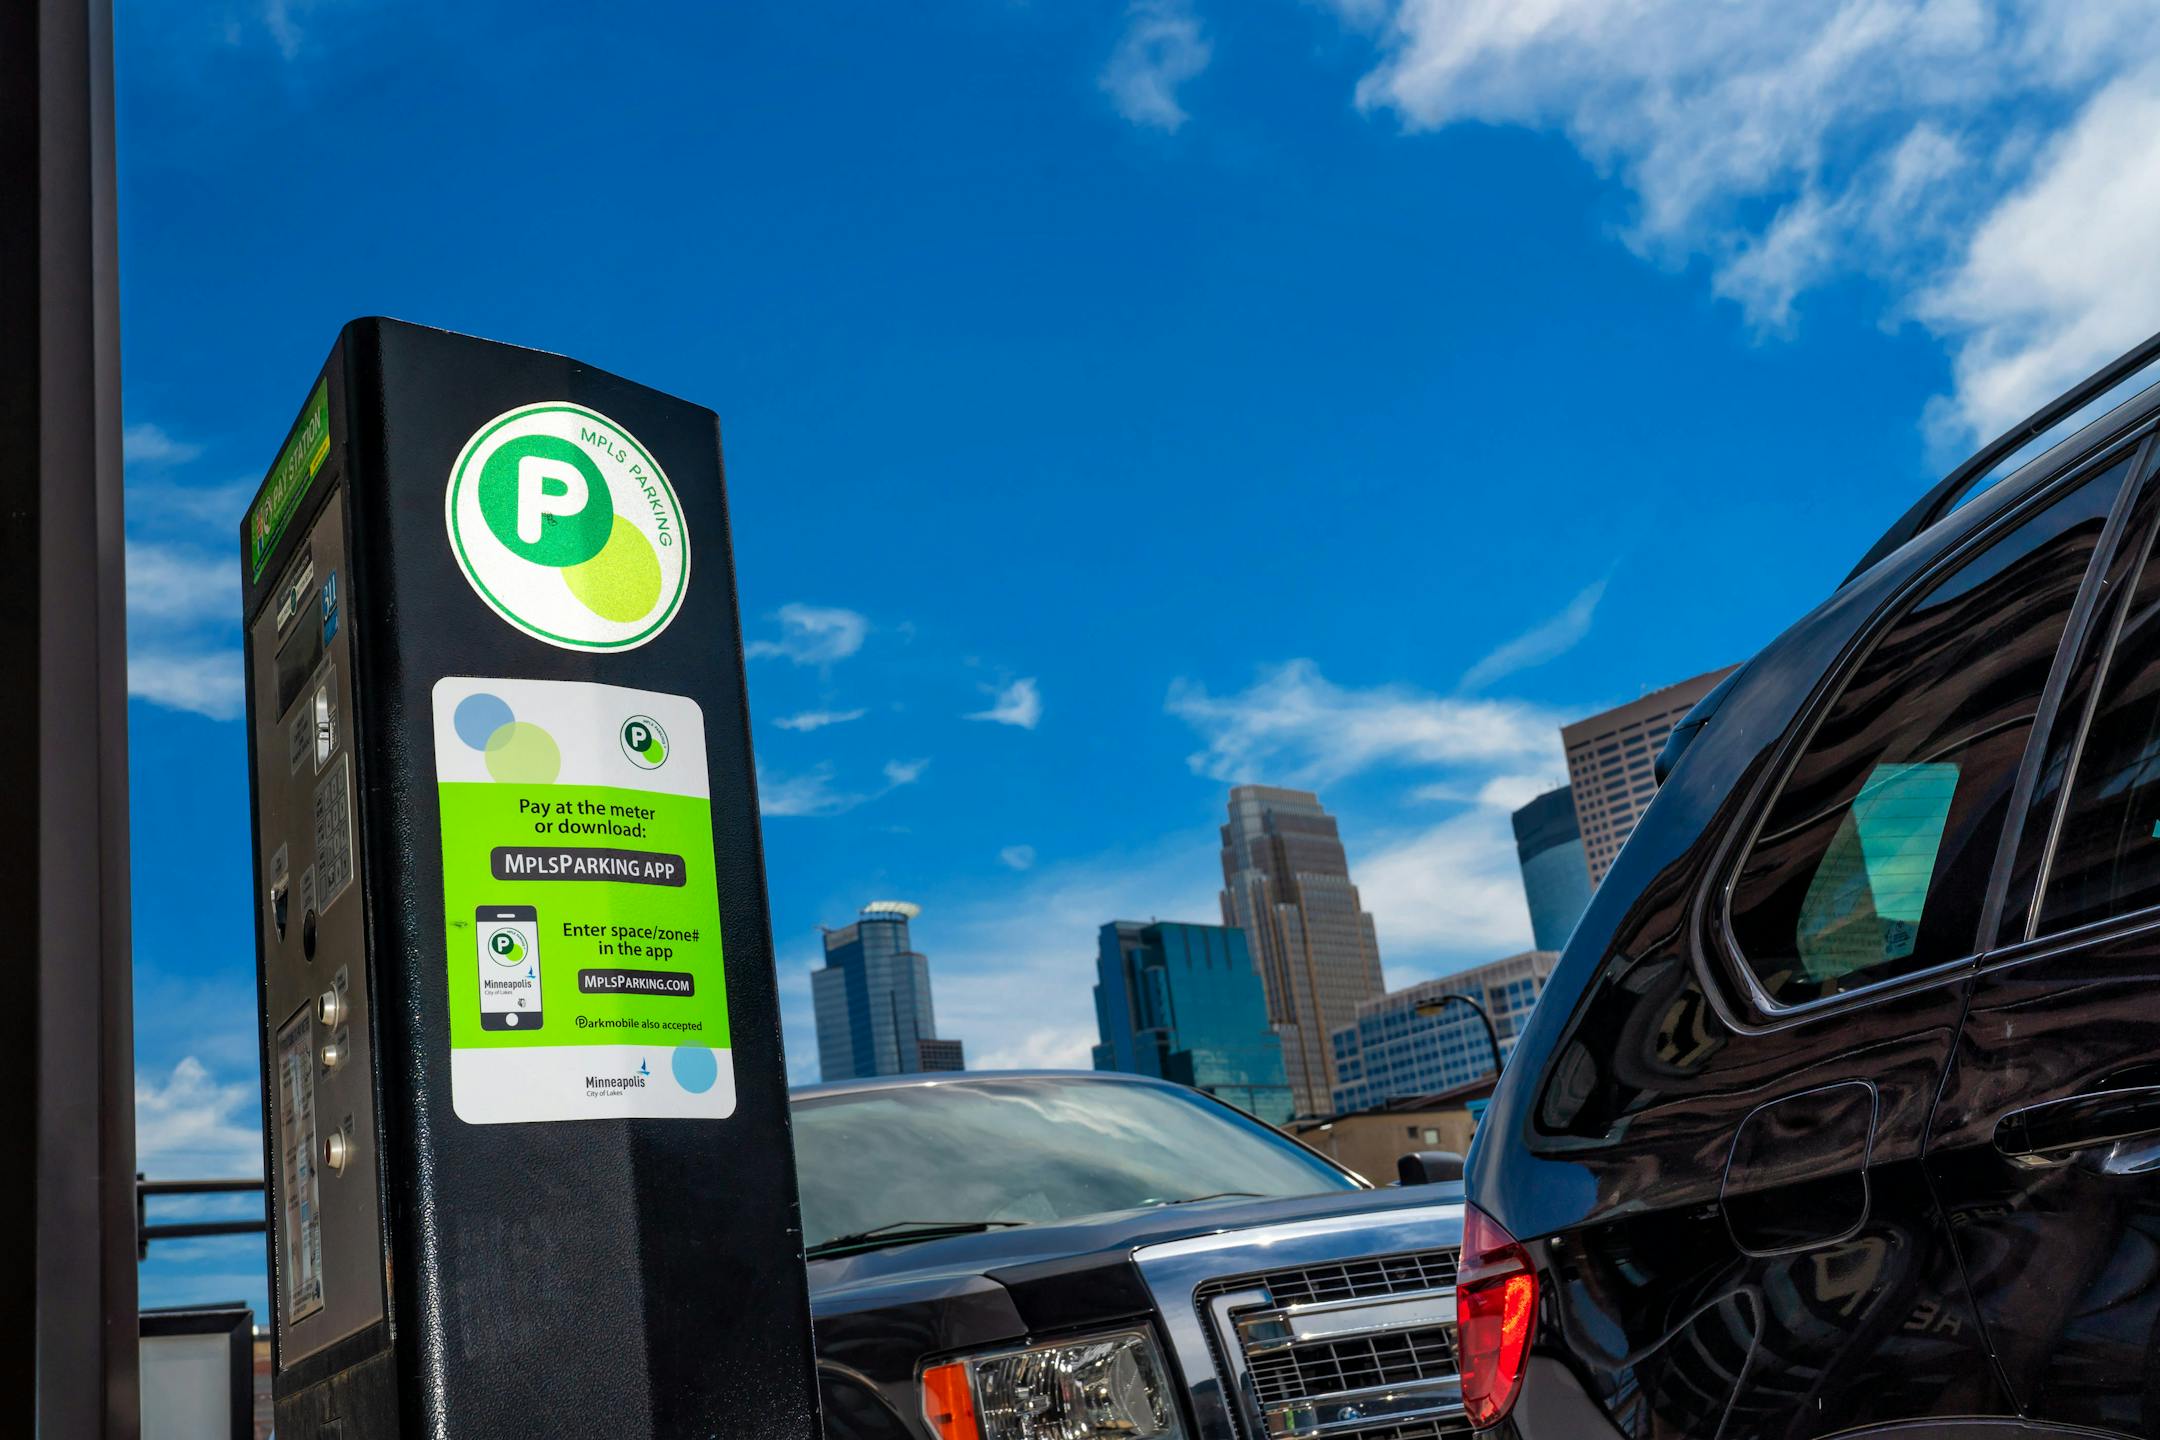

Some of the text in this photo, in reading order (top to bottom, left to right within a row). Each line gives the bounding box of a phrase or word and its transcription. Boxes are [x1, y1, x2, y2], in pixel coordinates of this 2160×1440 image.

[273, 469, 288, 510] PAY
[289, 406, 321, 481] STATION
[581, 427, 673, 547] MPLS PARKING
[517, 455, 589, 544] P
[631, 726, 647, 748] P
[519, 799, 656, 820] Pay at the meter
[535, 818, 646, 838] or download:
[644, 861, 675, 879] APP
[563, 922, 700, 942] Enter space/zone#
[497, 936, 510, 952] P
[599, 940, 673, 961] in the app
[484, 979, 532, 990] Minneapolis
[576, 1015, 703, 1032] Parkmobile also accepted
[586, 1075, 646, 1090] Minneapolis
[586, 1090, 598, 1098] City
[599, 1089, 606, 1097] of
